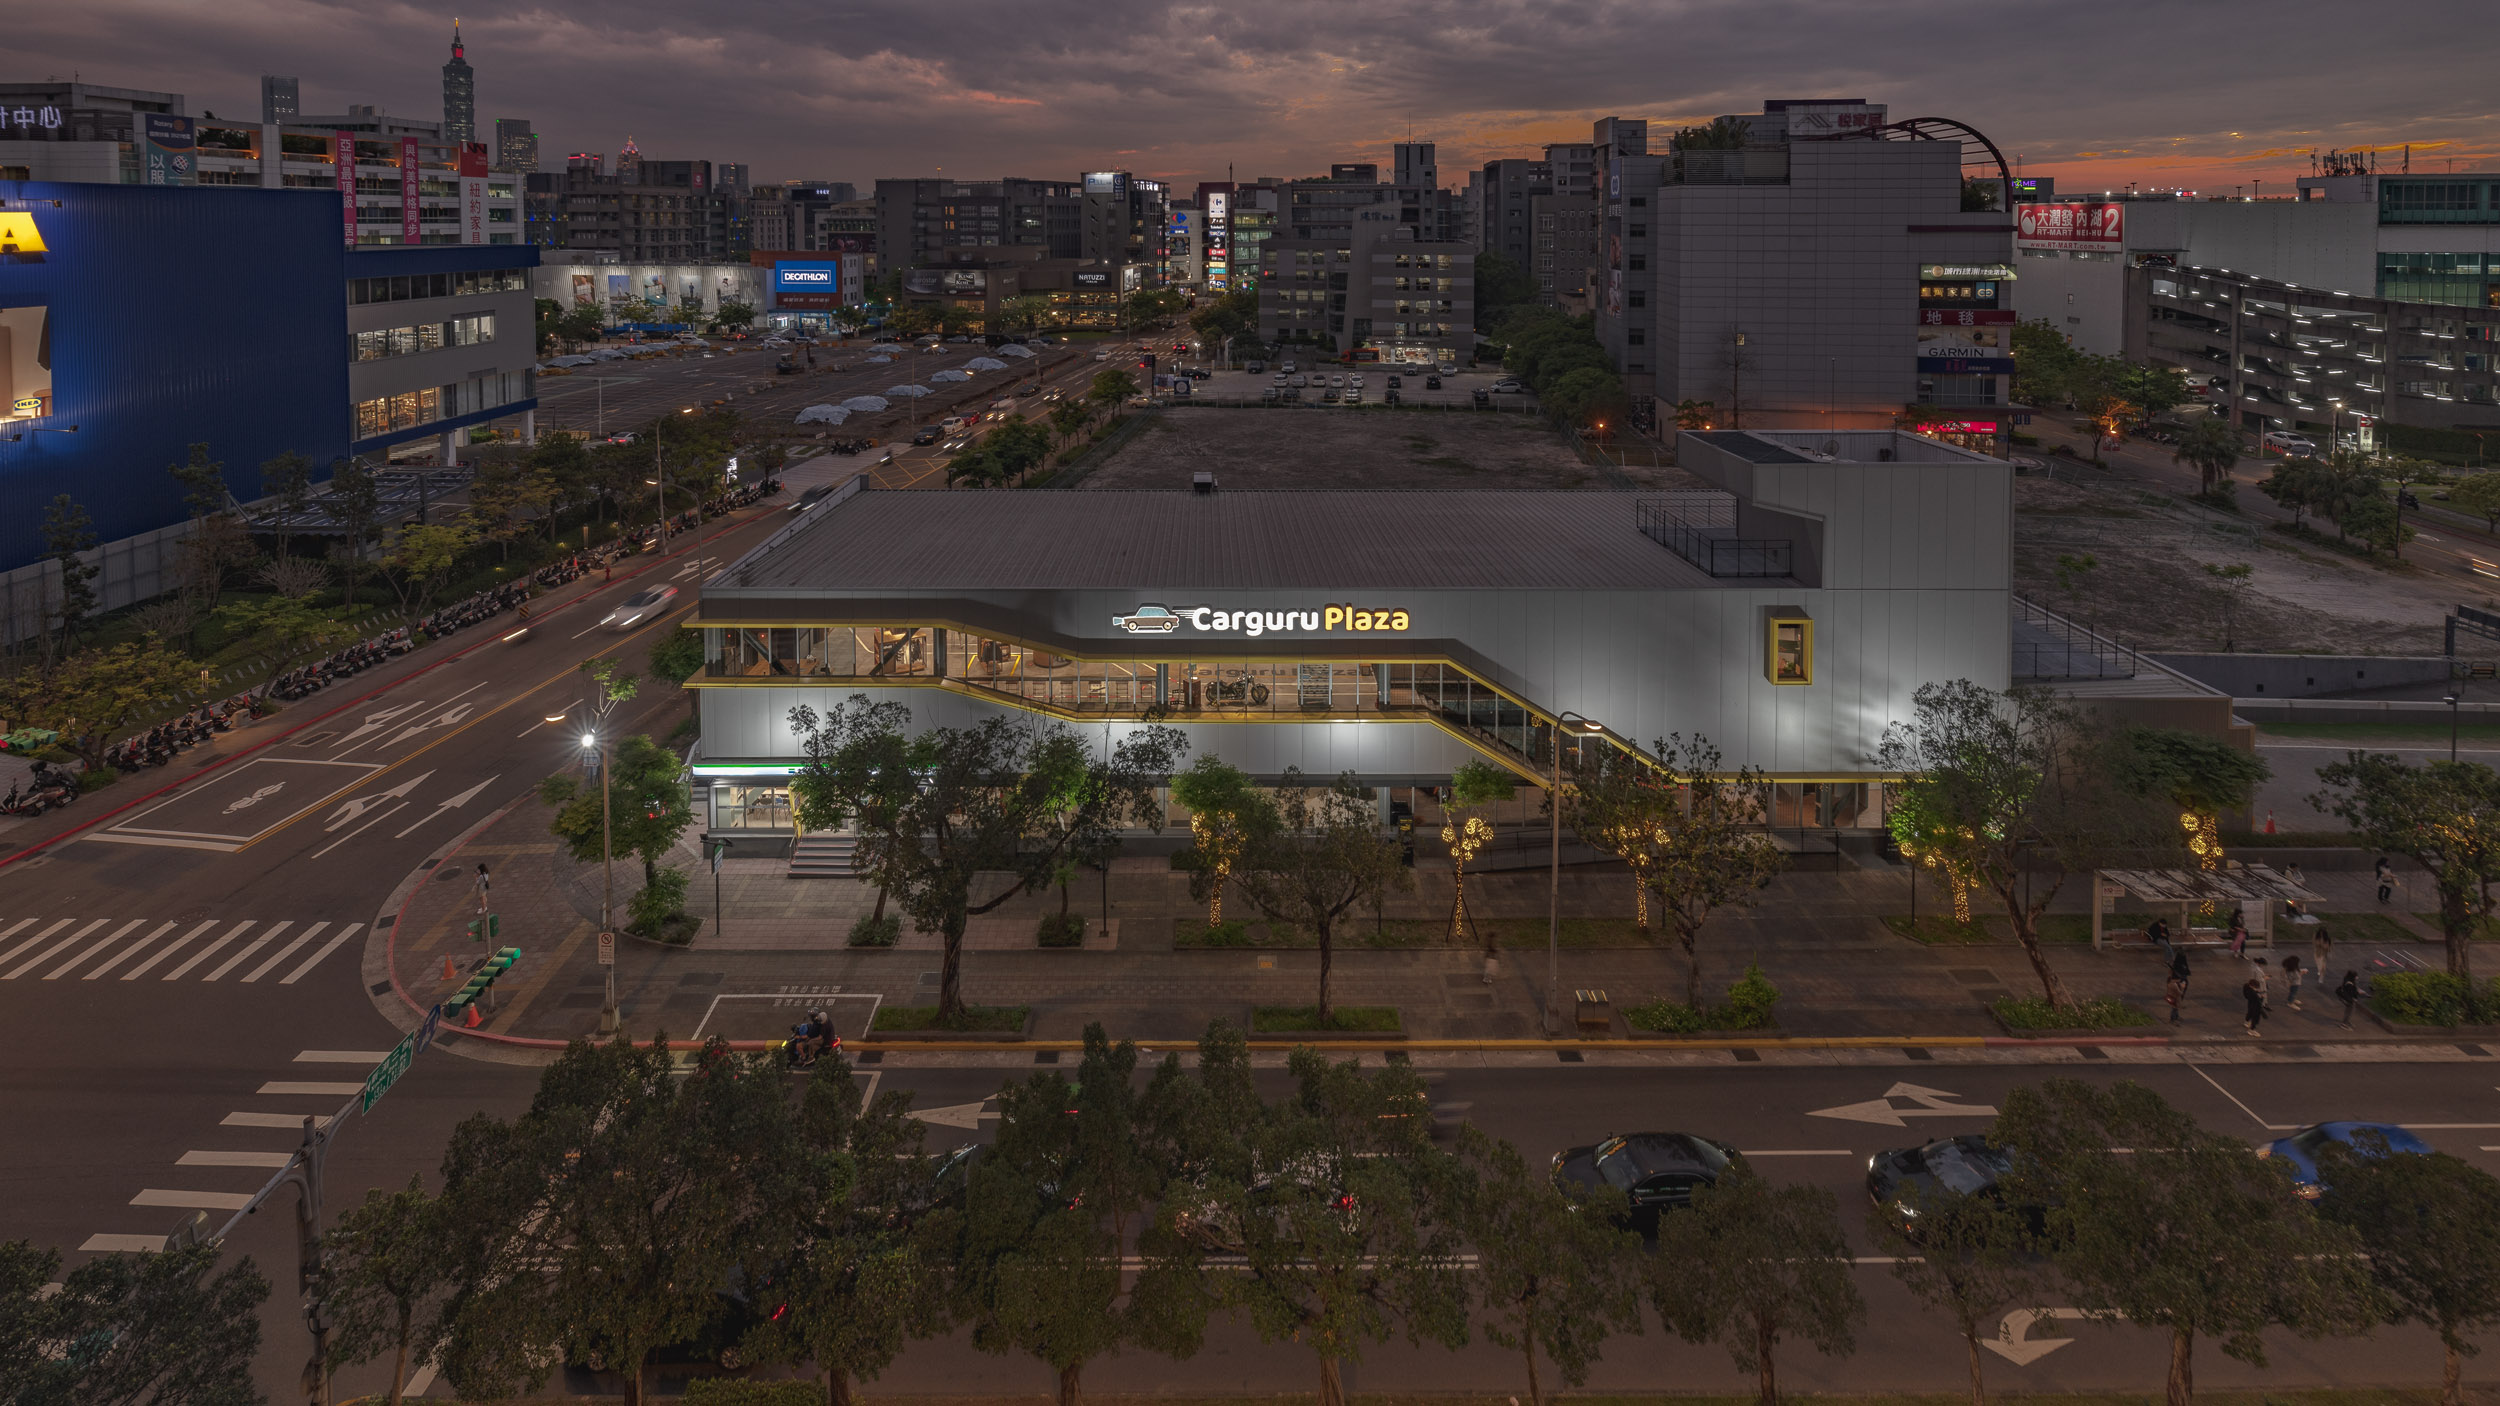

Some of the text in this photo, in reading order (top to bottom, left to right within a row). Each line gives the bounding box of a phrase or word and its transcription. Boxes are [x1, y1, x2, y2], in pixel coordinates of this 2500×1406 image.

[340, 139, 353, 208] 亞洲最頂級
[405, 144, 418, 236] 與歐美價格同步
[469, 183, 482, 244] 紐約家具
[2037, 208, 2119, 237] 大潤發 內湖 2
[2030, 241, 2106, 250] www.RT-MART.com.tw
[2037, 228, 2102, 237] RT-MART NEI-HU
[784, 273, 828, 281] DECATHLON
[1928, 348, 1984, 357] GARMIN
[1191, 603, 1410, 636] Carguru Plaza
